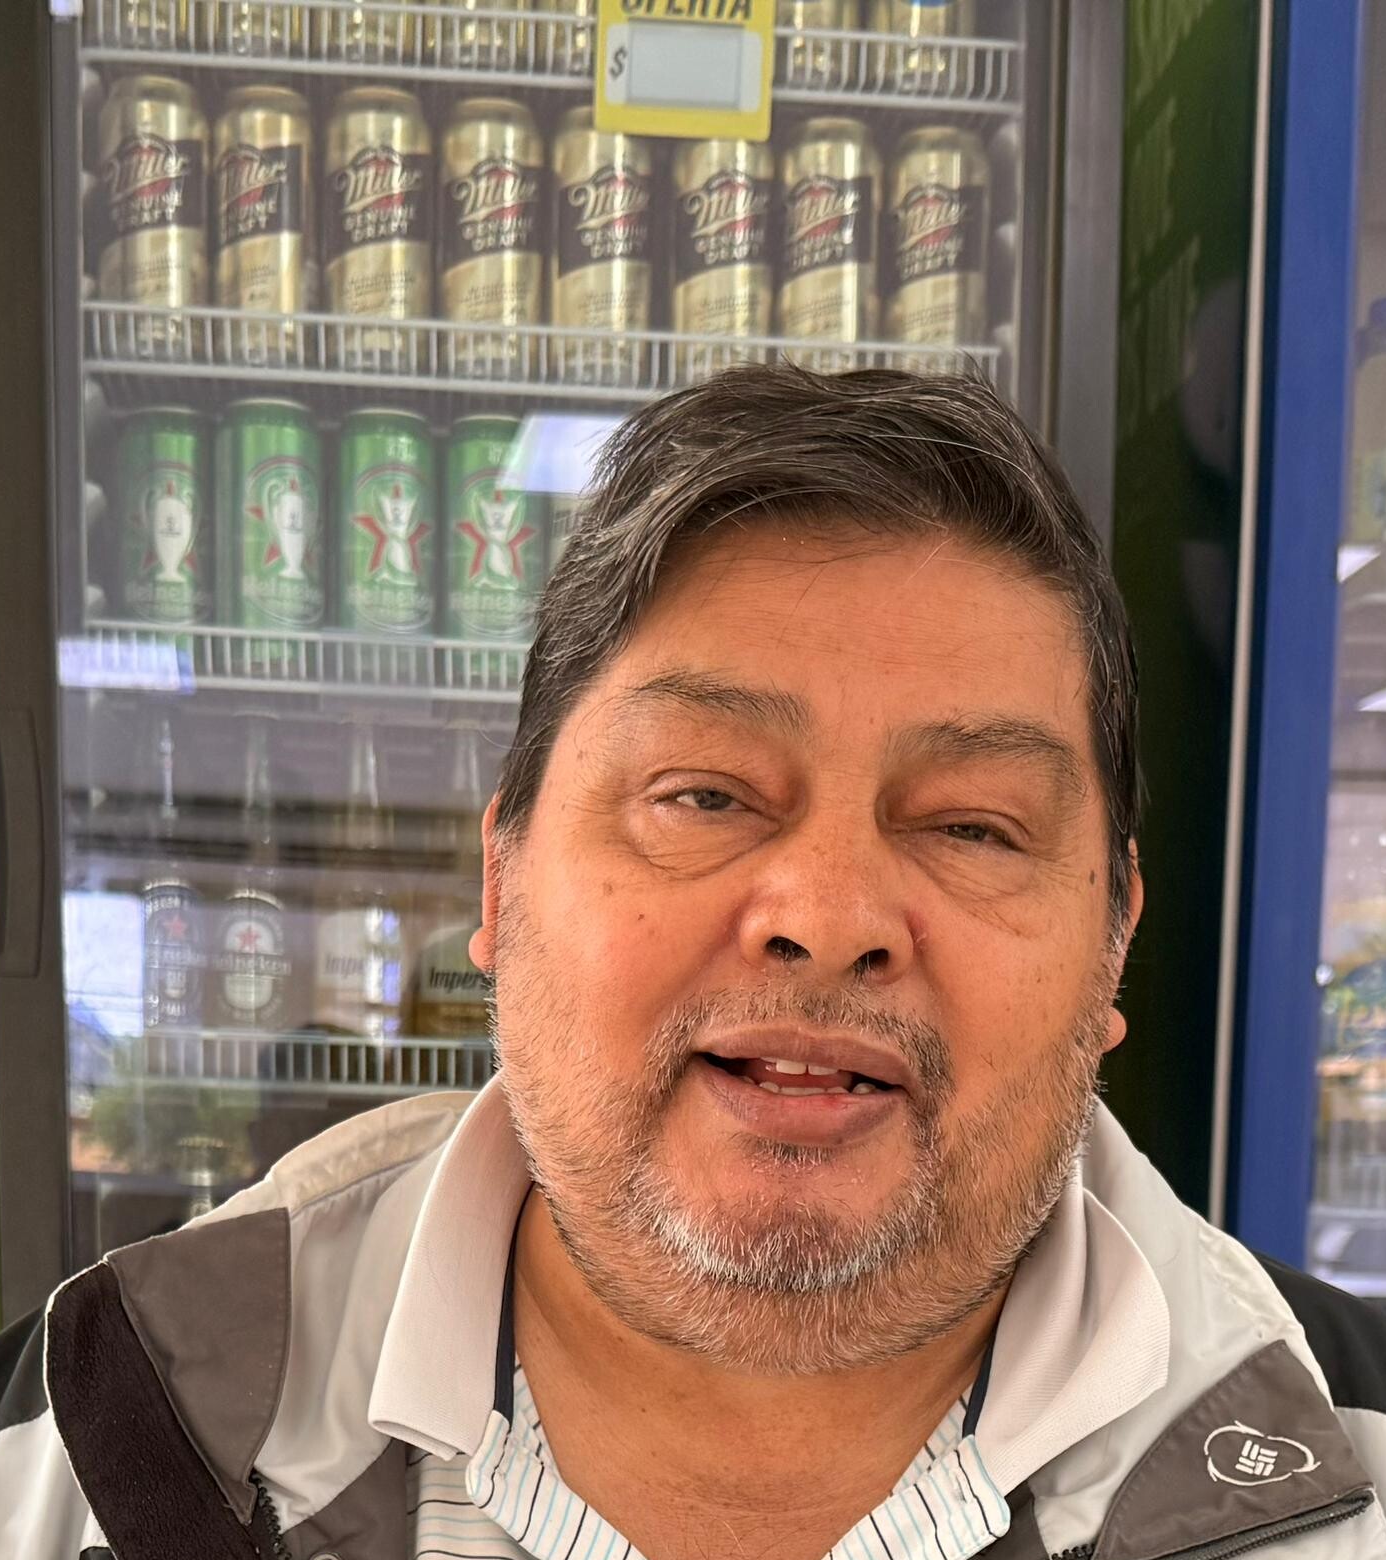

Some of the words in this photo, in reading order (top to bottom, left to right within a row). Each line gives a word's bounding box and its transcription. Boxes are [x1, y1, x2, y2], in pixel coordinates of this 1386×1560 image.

[609, 46, 627, 79] $
[335, 168, 421, 209] Miller
[453, 174, 536, 216] Miller
